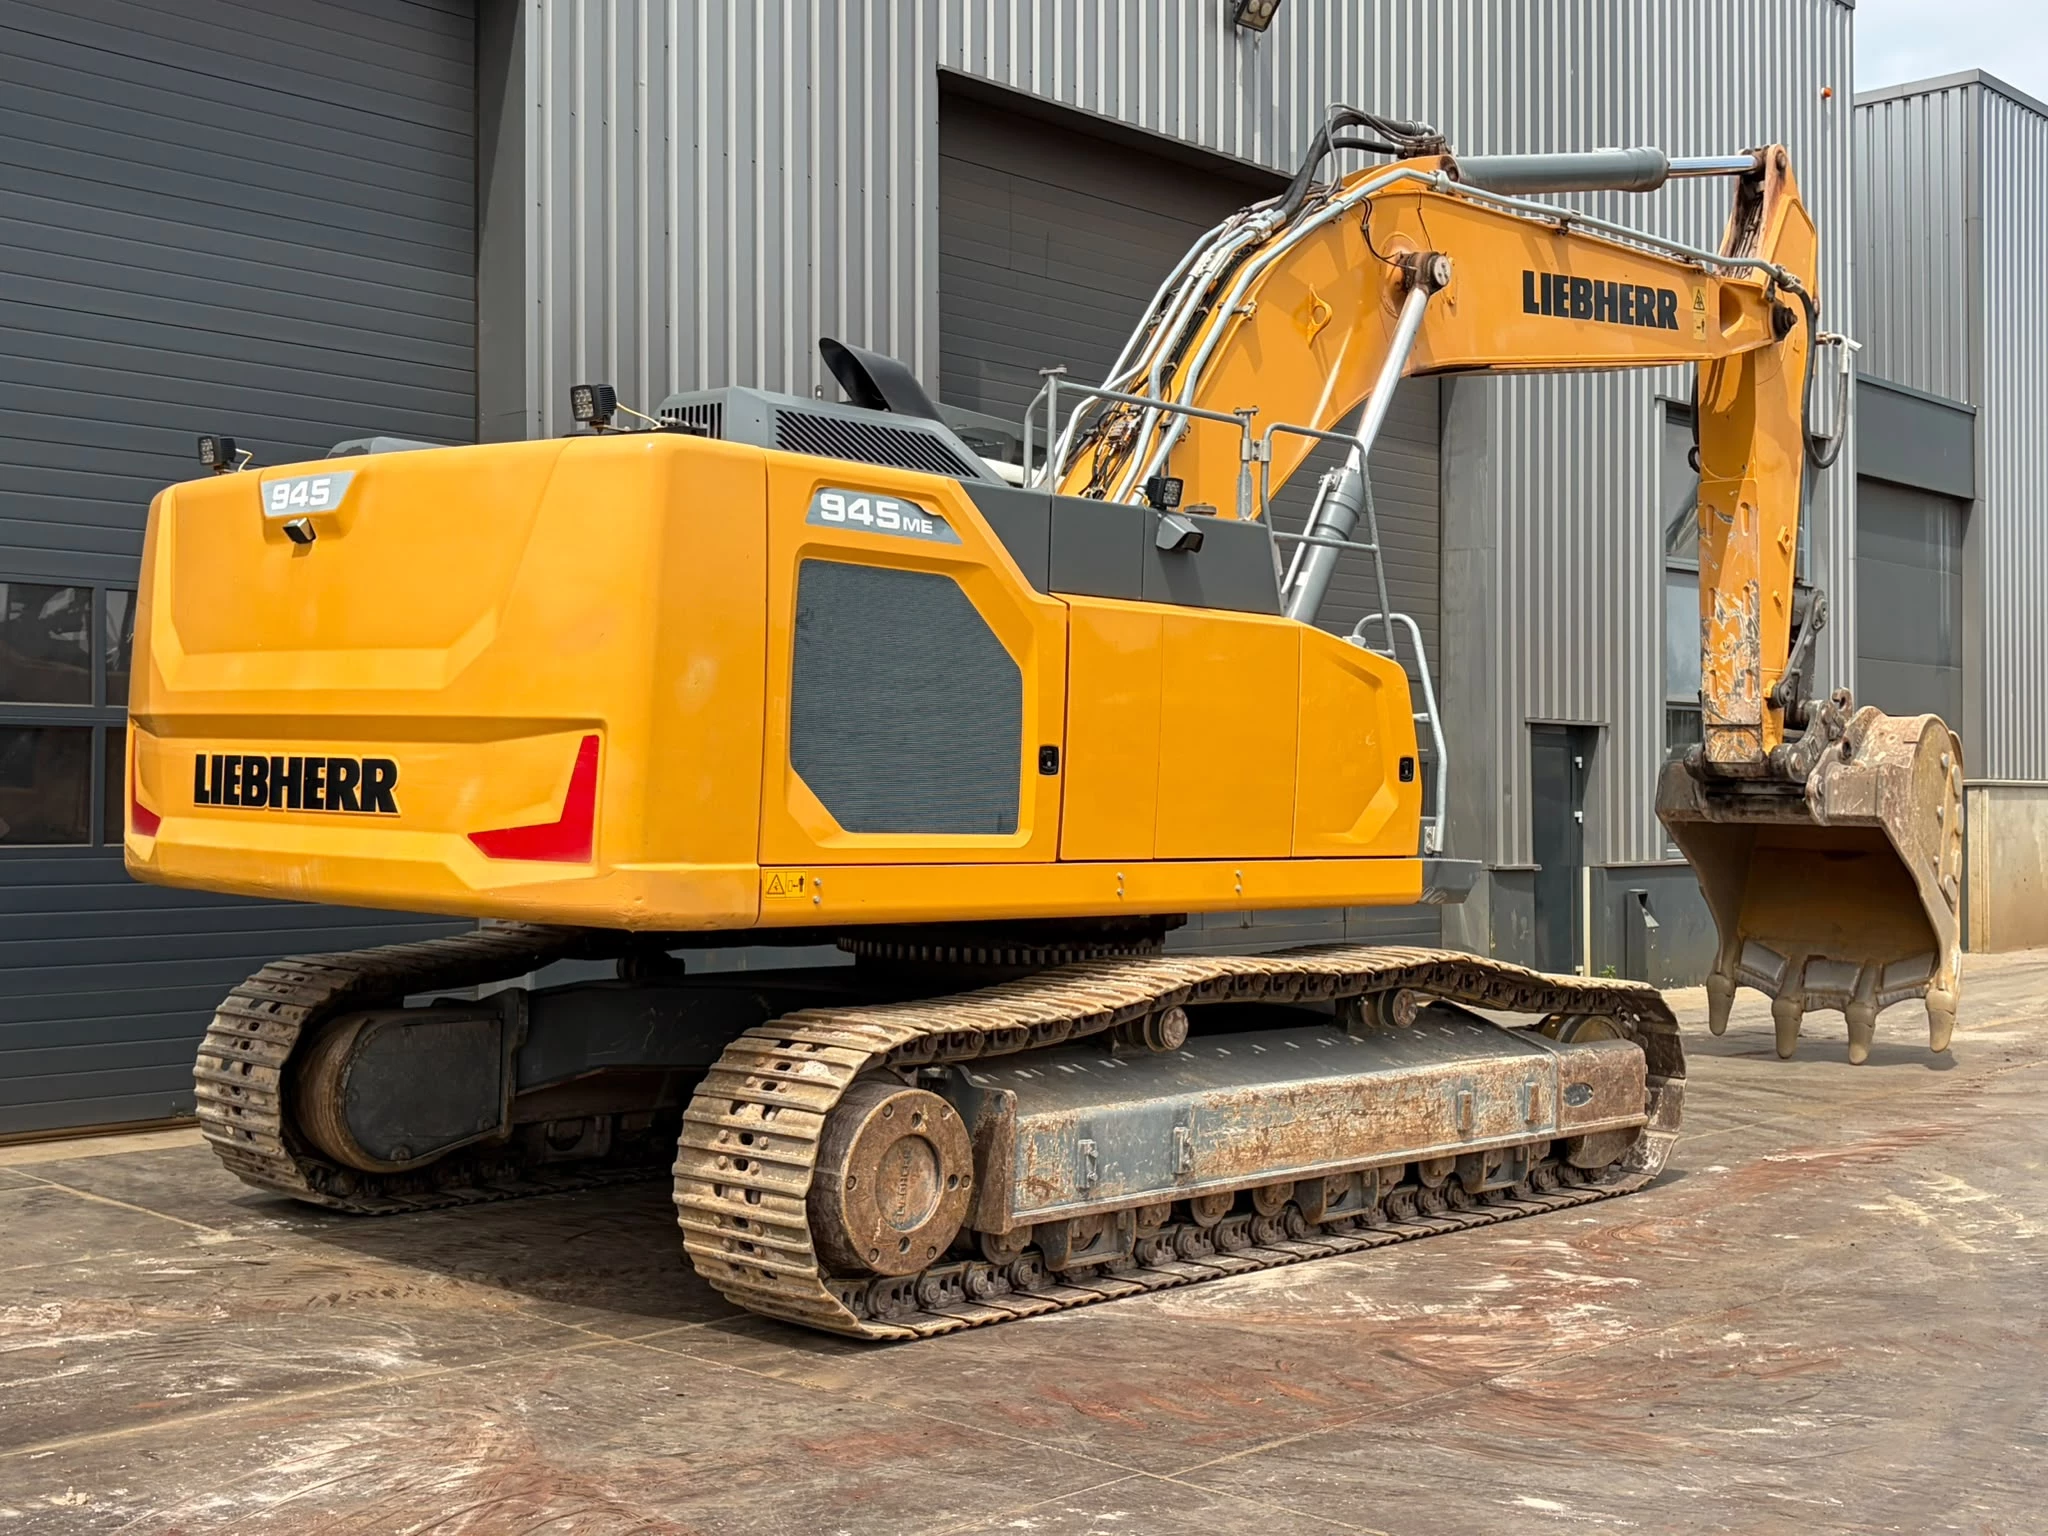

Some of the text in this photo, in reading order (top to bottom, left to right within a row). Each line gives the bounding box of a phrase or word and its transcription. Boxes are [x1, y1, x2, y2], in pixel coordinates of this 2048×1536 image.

[1522, 270, 1679, 330] LIEBHERR
[271, 478, 331, 511] 945
[194, 754, 399, 813] LIEBHERR
